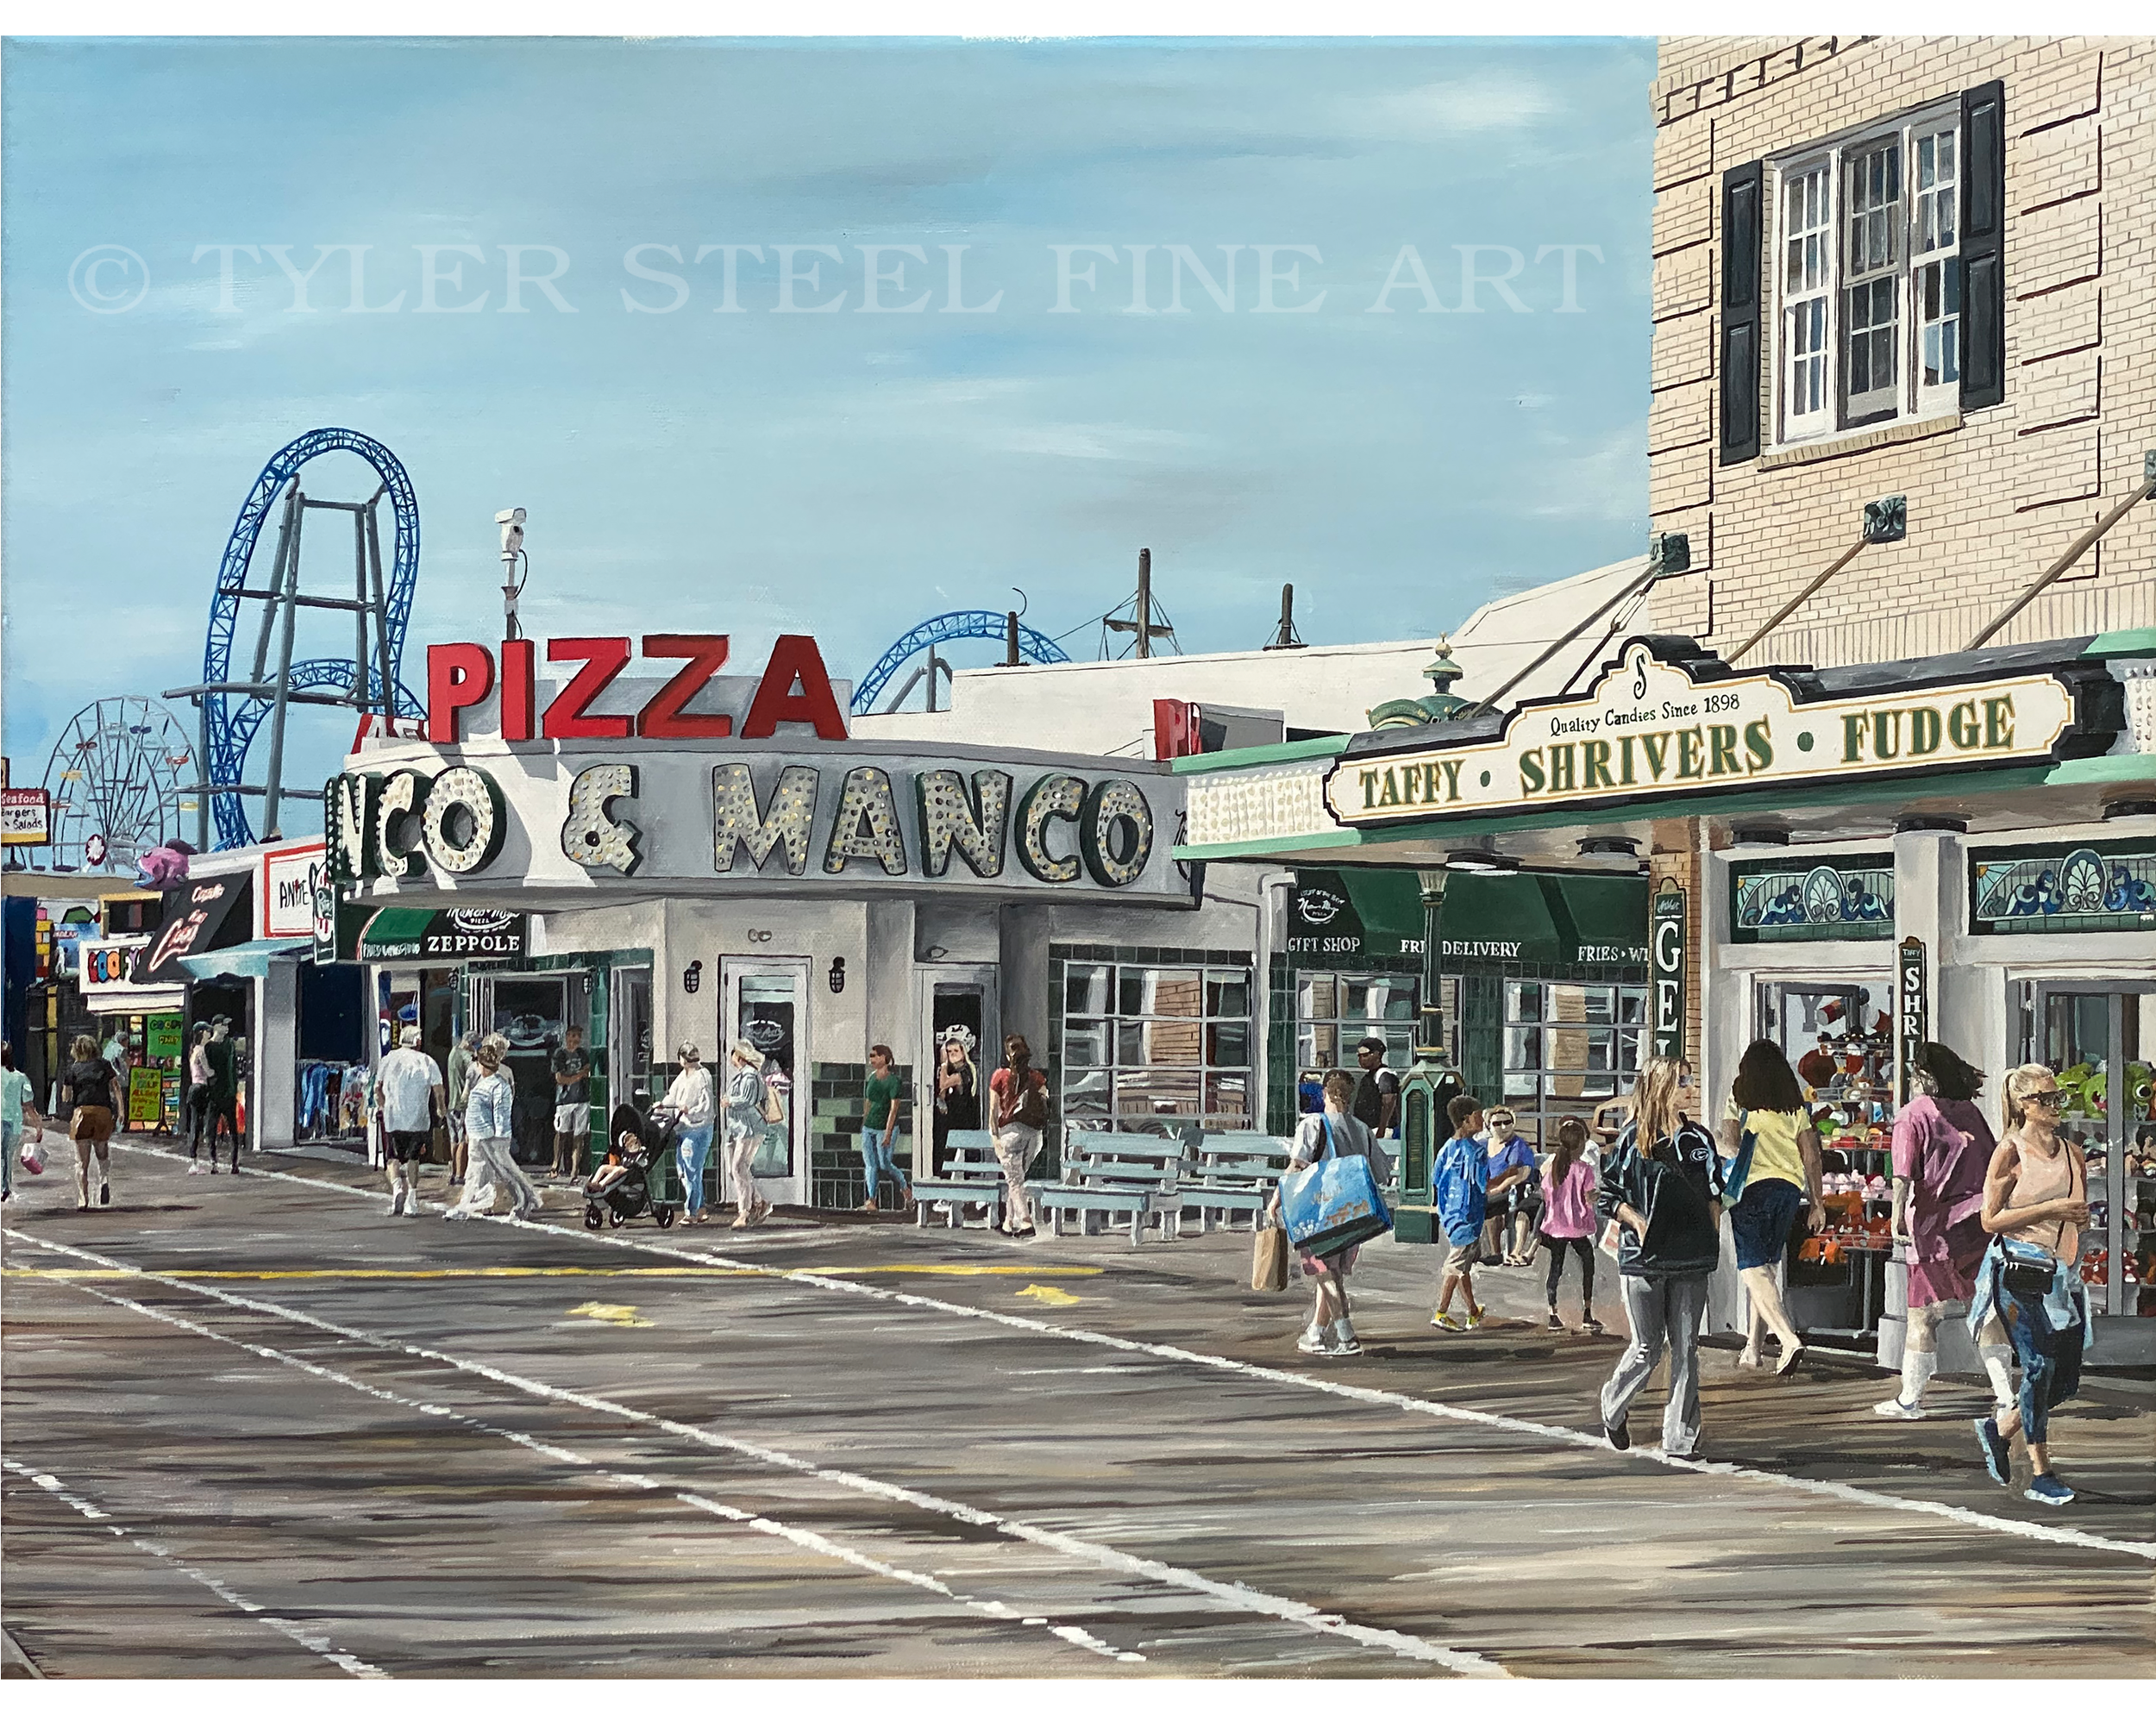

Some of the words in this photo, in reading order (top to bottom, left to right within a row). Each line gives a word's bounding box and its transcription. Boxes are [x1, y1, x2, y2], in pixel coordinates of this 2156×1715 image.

[427, 634, 849, 743] PIZZA
[1551, 717, 1601, 736] Quality
[1605, 707, 1656, 727] Candies
[1662, 701, 1698, 719] Since
[1703, 694, 1740, 713] 1898
[1359, 759, 1466, 809] TAFFY
[1519, 715, 1775, 798] SHRIVERS
[1839, 692, 2015, 764] FUDGE
[561, 764, 643, 877] &
[711, 763, 1154, 887] MANCO
[427, 935, 521, 952] ZEPPOLE
[1288, 937, 1319, 953] GIFT
[1323, 937, 1360, 953] SHOP
[1442, 940, 1521, 958] DELIVERY
[1577, 946, 1619, 961] FRIES
